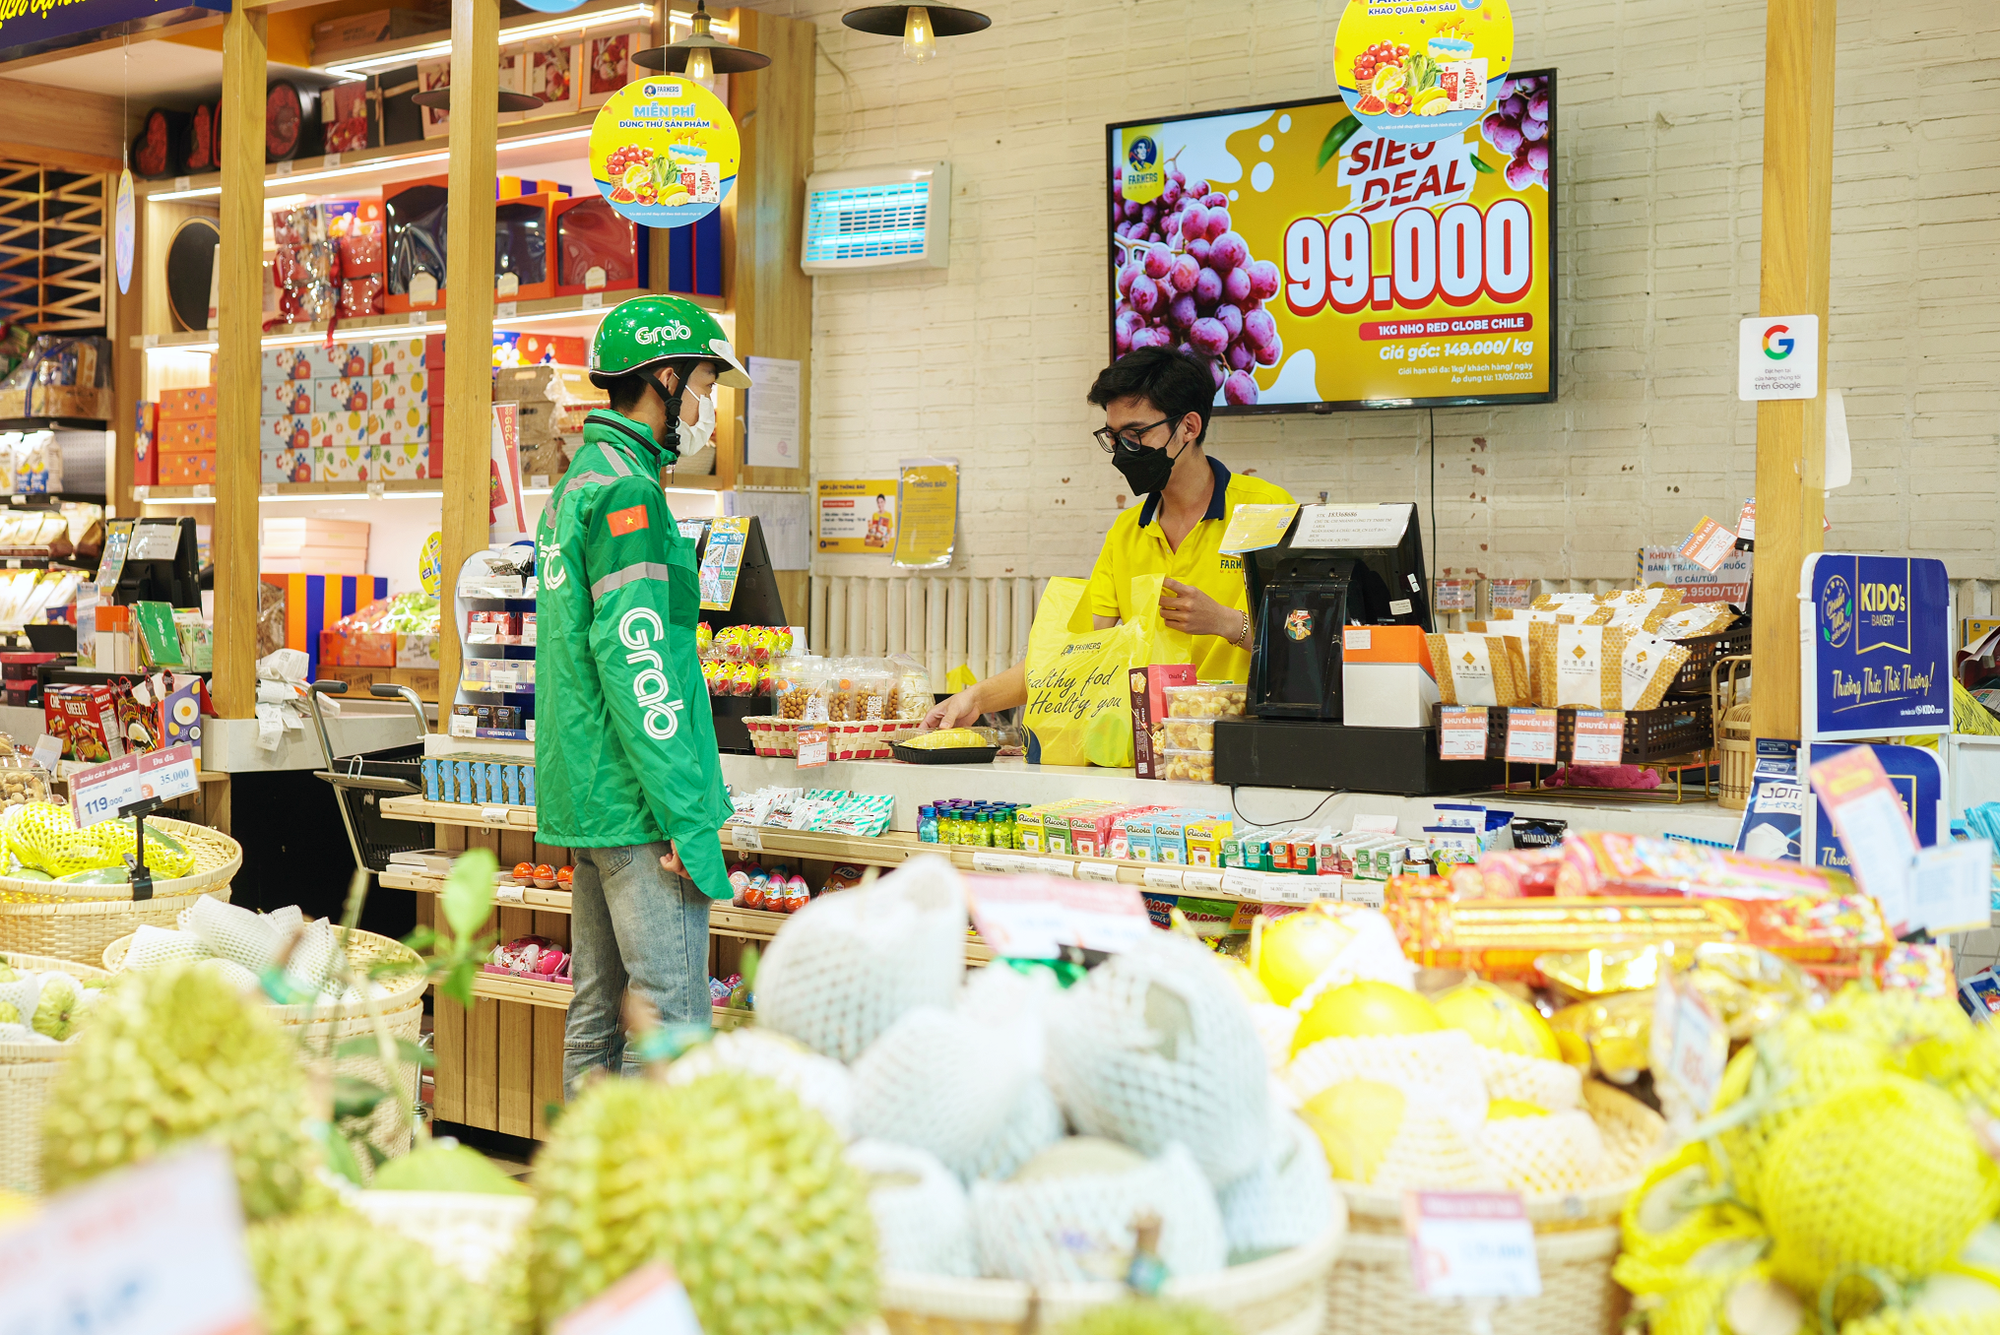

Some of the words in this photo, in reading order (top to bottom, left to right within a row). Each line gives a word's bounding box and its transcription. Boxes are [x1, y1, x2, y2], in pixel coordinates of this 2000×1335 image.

[1368, 7, 1393, 15] KHAO
[1395, 5, 1414, 15] QUÀ
[1416, 5, 1436, 14] ĐẬM
[1438, 3, 1456, 11] SÂU
[633, 102, 670, 118] MIỄN
[671, 103, 697, 118] PHÍ
[619, 119, 644, 128] DÙNG
[645, 119, 663, 128] THỬ
[664, 118, 683, 128] SẢN
[684, 118, 710, 128] PHẨM
[1128, 172, 1158, 185] FARMERS
[1359, 160, 1466, 214] DEAL
[1284, 198, 1533, 317] 99.000
[635, 320, 692, 345] Grab
[1378, 325, 1398, 336] 1KG
[1400, 323, 1424, 335] NHO
[1426, 321, 1449, 333] RED
[1451, 318, 1489, 332] GLOBE
[1491, 317, 1525, 329] CHILE
[1762, 324, 1795, 360] G
[1379, 344, 1404, 360] Giá
[1408, 342, 1441, 362] gốc:
[1512, 338, 1534, 356] kg
[1398, 365, 1412, 375] Giới
[1413, 366, 1427, 376] hạn
[1428, 365, 1438, 375] tối
[1467, 363, 1490, 372] khách
[1490, 362, 1513, 373] hàng/
[1514, 362, 1533, 372] ngày
[1451, 374, 1462, 384] Áp
[1463, 375, 1482, 384] dụng
[1494, 372, 1533, 382] 13/05/2023
[1772, 381, 1801, 391] Google
[1673, 563, 1699, 571] TRÁNG
[1723, 562, 1746, 570] RUỐC
[1860, 583, 1906, 612] KIDO's
[1871, 614, 1895, 627] BAKERY
[618, 607, 685, 740] Grab
[1090, 697, 1122, 718] you
[1444, 716, 1471, 724] KHUYẾN
[1473, 716, 1485, 724] MÃI
[1511, 718, 1540, 727] KHUYẾN
[1542, 719, 1555, 727] MÃI
[1578, 720, 1608, 730] KHUYẾN
[1610, 721, 1622, 730] MÃI
[1464, 741, 1475, 750] 35
[1532, 741, 1544, 751] 35
[1598, 744, 1610, 754] 35
[813, 750, 821, 758] 19
[95, 771, 106, 780] CÁT
[119, 762, 131, 772] LỘC
[160, 768, 189, 785] 35.000
[1018, 814, 1040, 823] Ricola
[1045, 817, 1067, 826] Ricola
[1072, 819, 1095, 829] Ricola
[1127, 825, 1151, 833] Ricola
[1156, 826, 1180, 835] Ricola
[1187, 828, 1211, 838] Ricola
